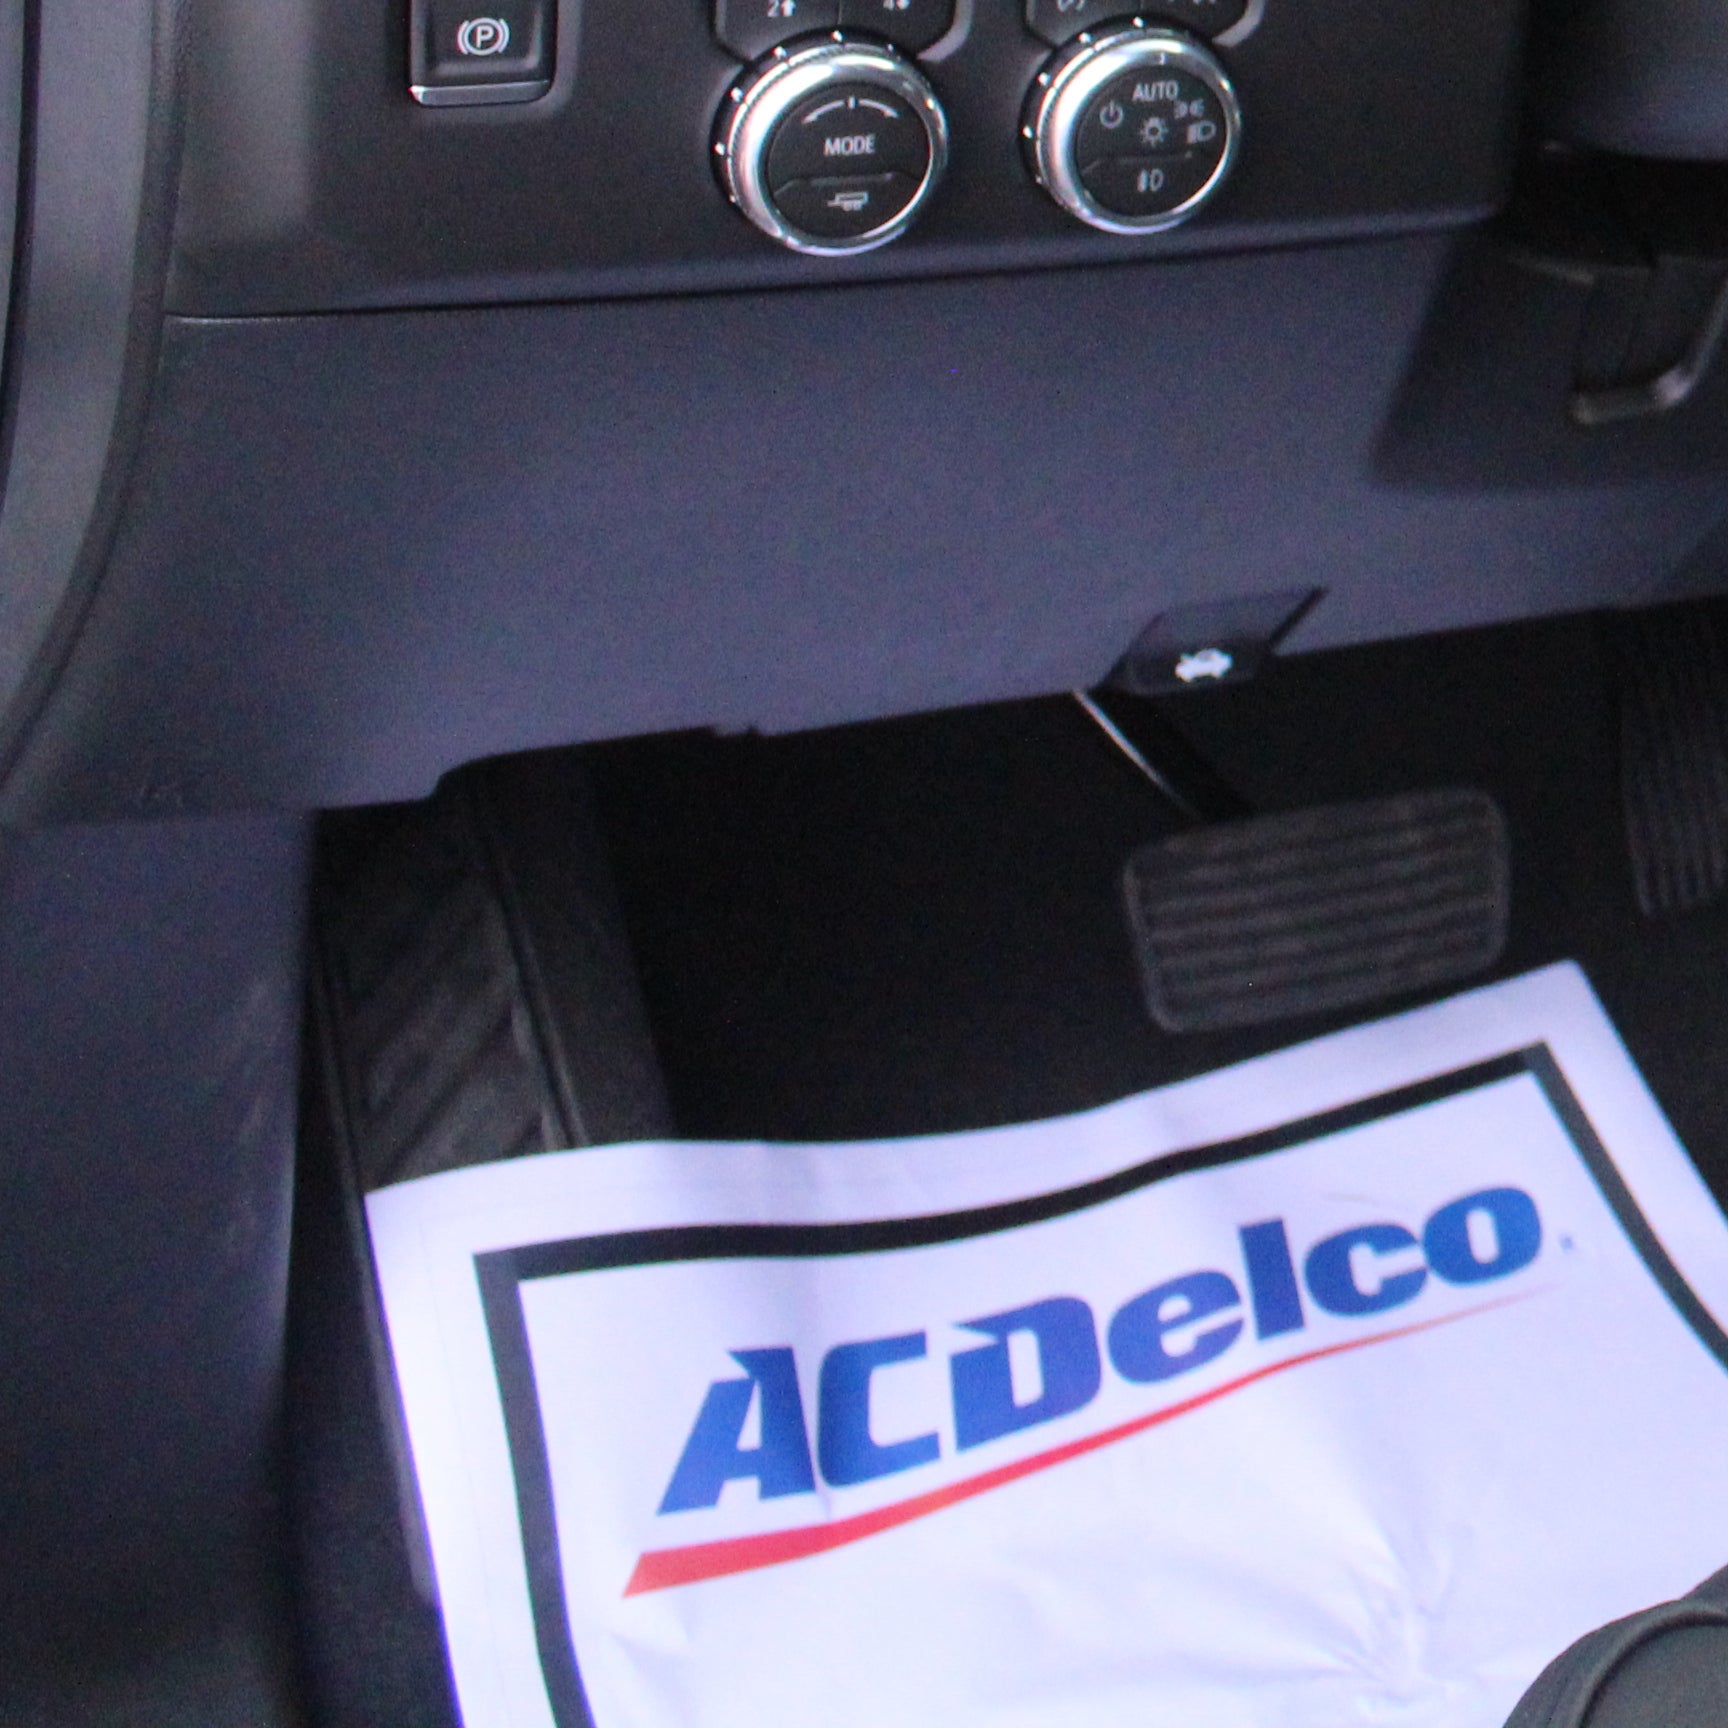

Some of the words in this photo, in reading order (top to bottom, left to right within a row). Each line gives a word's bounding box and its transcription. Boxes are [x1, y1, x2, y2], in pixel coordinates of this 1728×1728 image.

[1132, 80, 1179, 102] AUTO
[824, 134, 875, 156] MODE
[657, 1185, 1543, 1516] ACDelco
